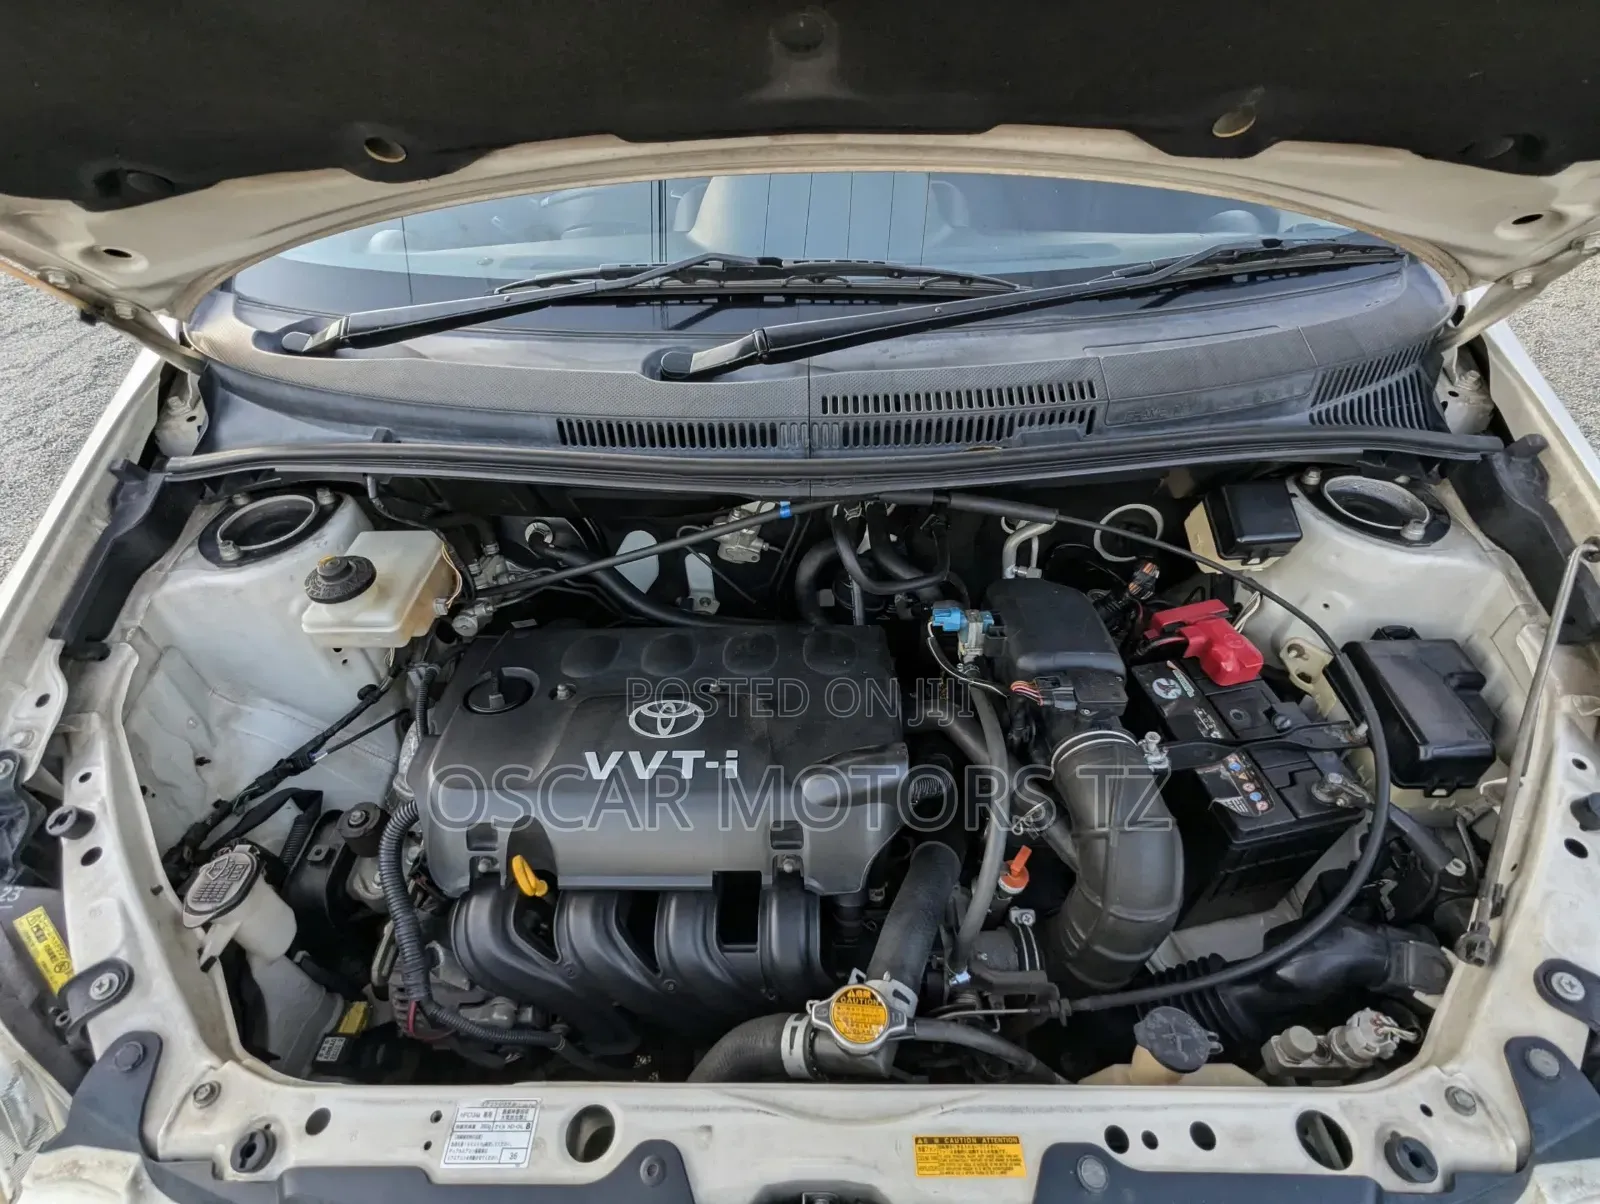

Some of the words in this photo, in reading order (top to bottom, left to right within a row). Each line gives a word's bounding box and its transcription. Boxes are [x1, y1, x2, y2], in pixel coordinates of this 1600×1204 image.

[584, 750, 740, 780] VVT-i
[840, 996, 879, 1006] CAUTION
[981, 1136, 1018, 1144] ATTENTION
